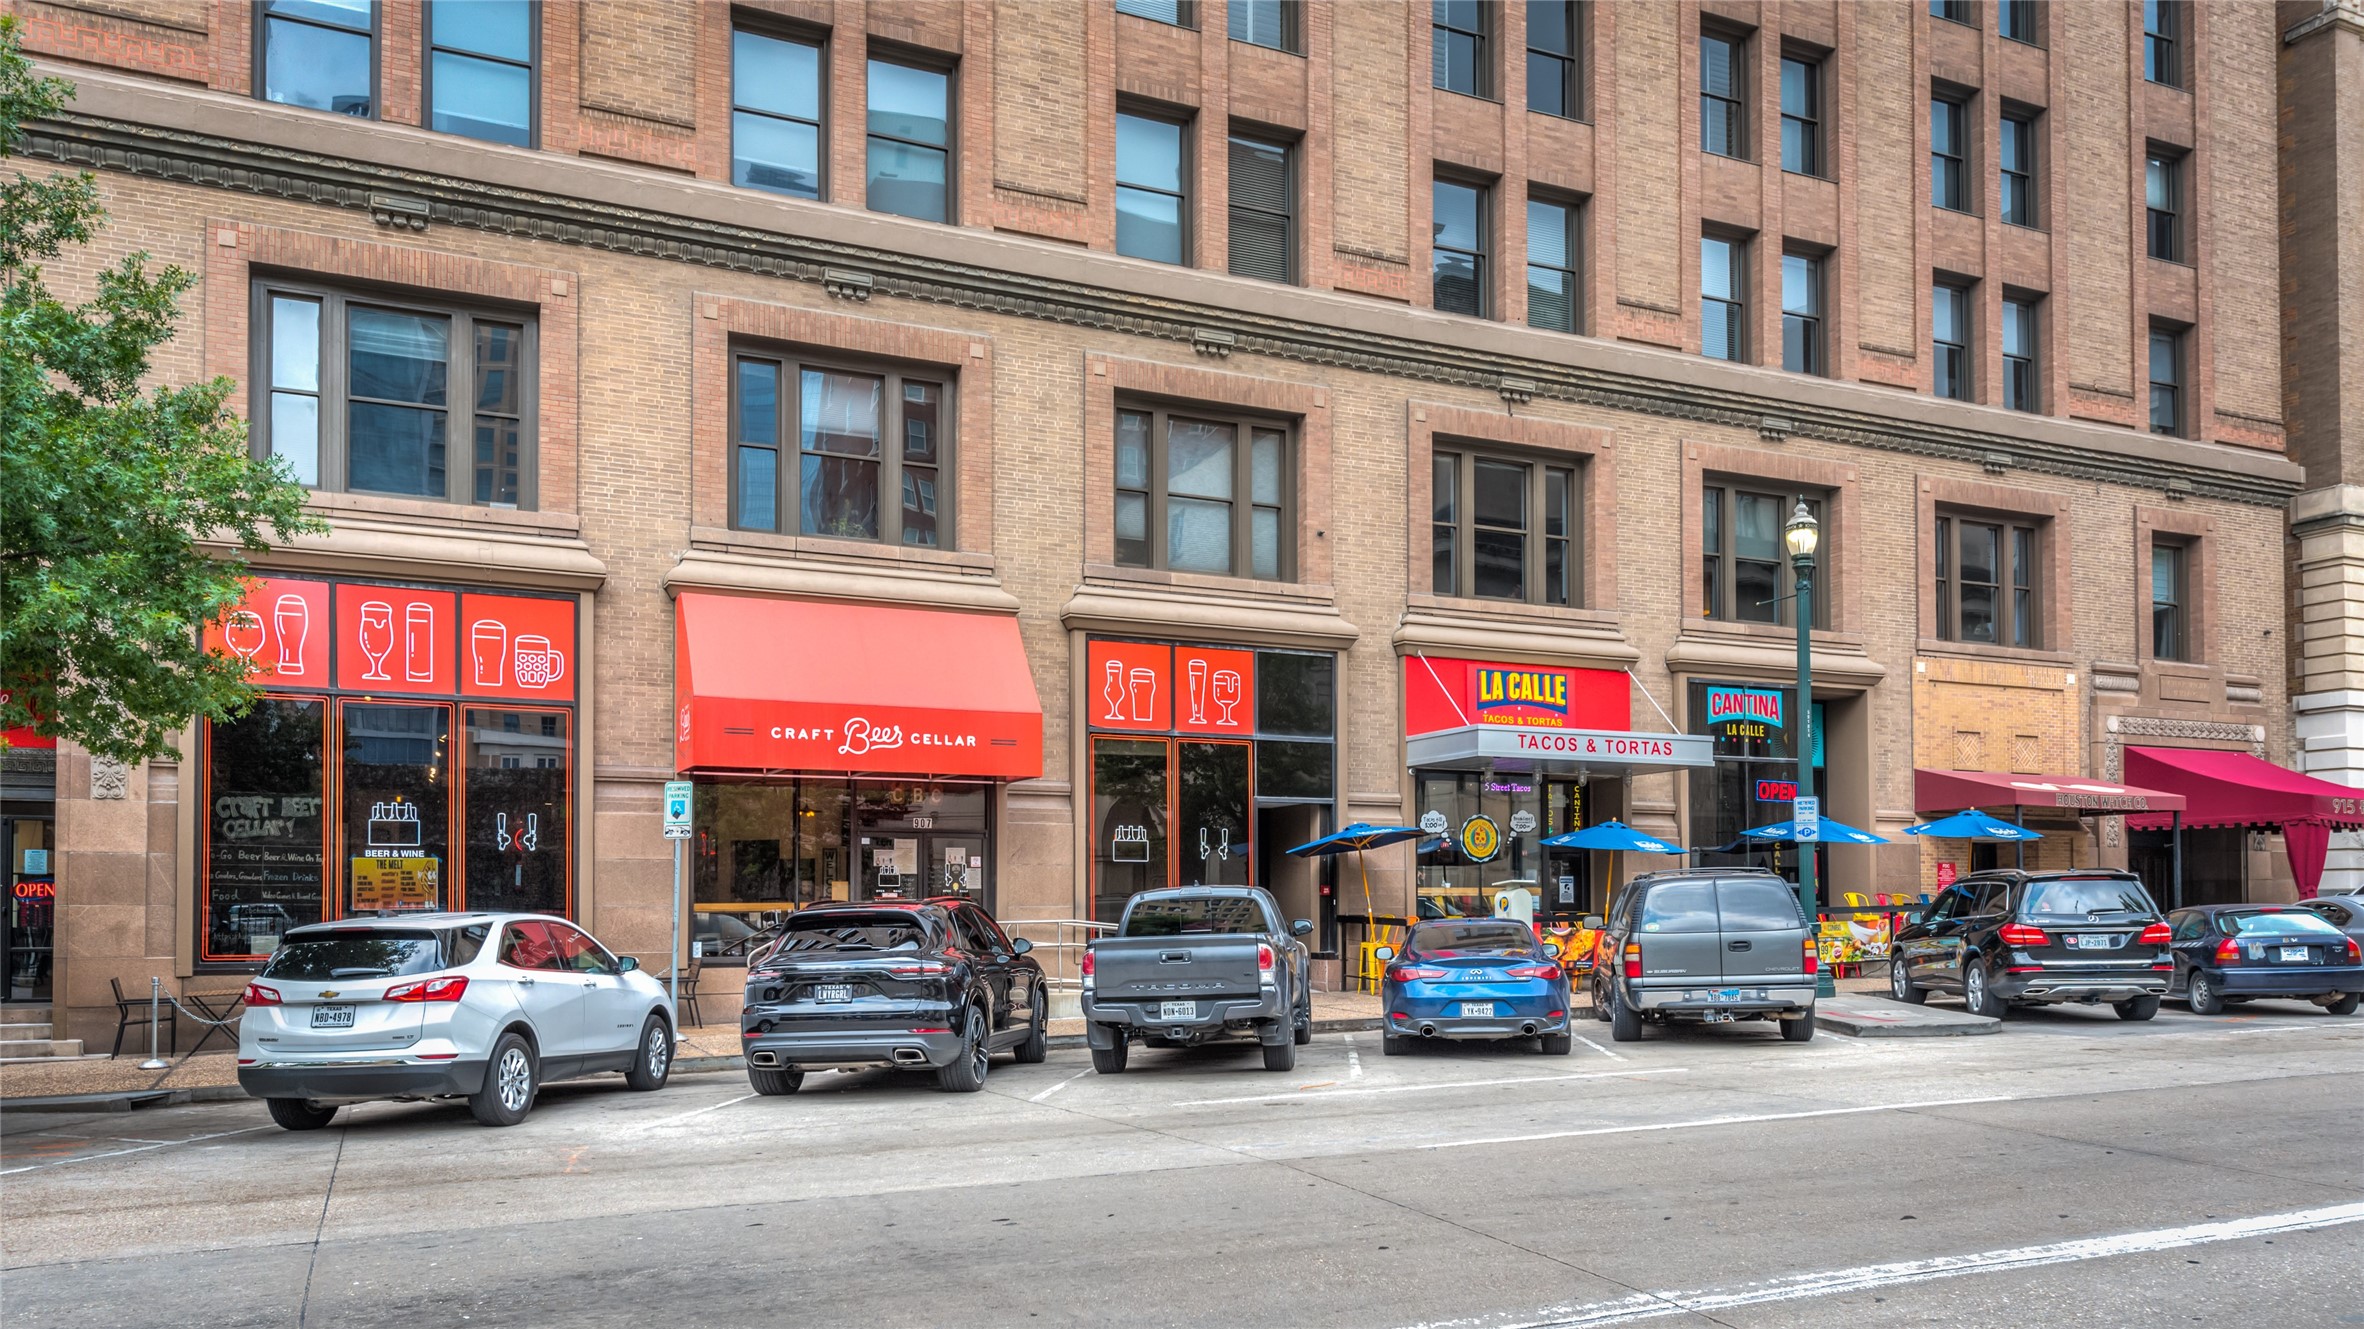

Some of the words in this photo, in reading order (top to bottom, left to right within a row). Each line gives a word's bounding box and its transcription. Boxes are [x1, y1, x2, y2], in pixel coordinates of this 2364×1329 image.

[1479, 671, 1504, 702] LA
[1506, 672, 1566, 706] CALLE
[1711, 692, 1780, 722] CANTINA
[1483, 714, 1514, 724] TACOS
[1517, 717, 1523, 725] &
[1526, 717, 1563, 727] TORTAS
[771, 727, 834, 740] CRAFT
[838, 717, 904, 755] Beer
[910, 733, 976, 747] CELLAR
[1727, 723, 1737, 736] LA
[1739, 724, 1764, 736] CALLE
[1518, 734, 1578, 752] TACOS
[1587, 739, 1597, 753] &
[1605, 739, 1673, 756] TORTAS
[1491, 782, 1511, 791] Street
[1511, 782, 1531, 792] Tacos
[1758, 782, 1797, 800] OPEN
[2056, 793, 2099, 808] HOUSTON
[2333, 798, 2355, 814] 915
[914, 818, 932, 828] 907
[238, 850, 261, 860] Beer
[264, 852, 280, 860] Beer
[288, 853, 304, 862] Wine
[376, 860, 387, 869] THE
[389, 860, 403, 869] MELT
[264, 871, 288, 880] Frozen
[293, 872, 318, 881] Drinks
[15, 883, 55, 897] OPEN
[212, 889, 239, 900] Food
